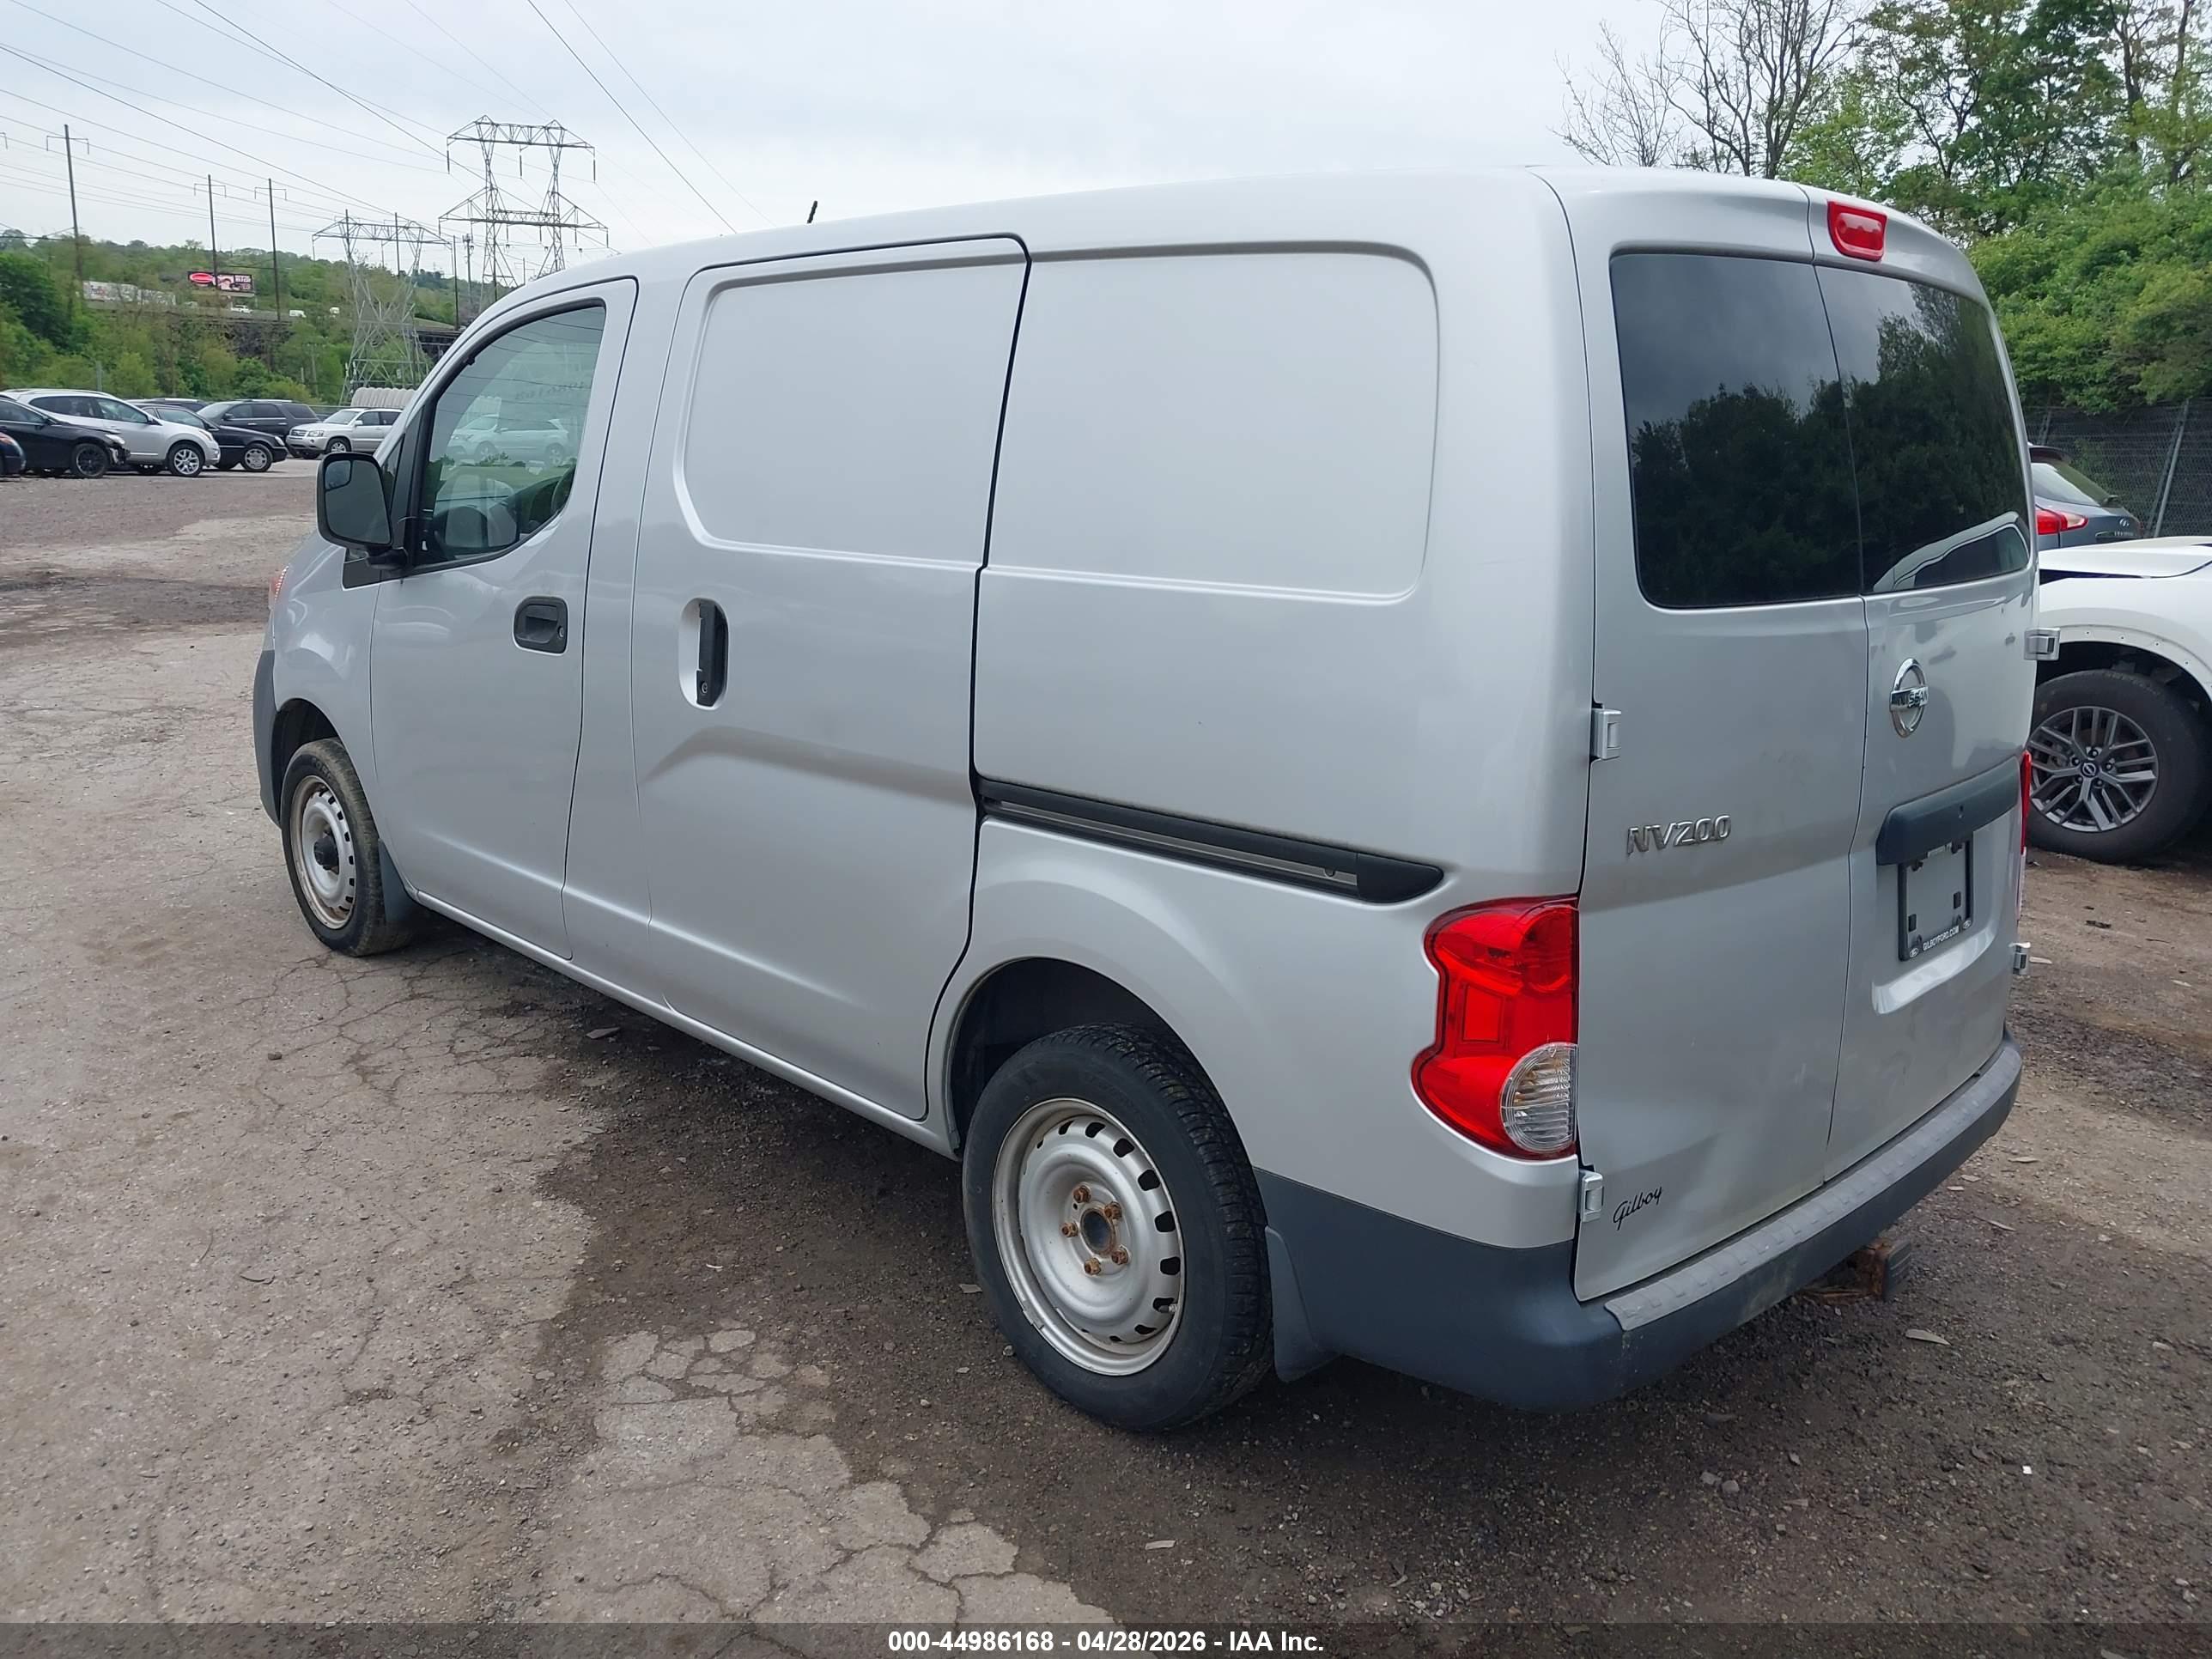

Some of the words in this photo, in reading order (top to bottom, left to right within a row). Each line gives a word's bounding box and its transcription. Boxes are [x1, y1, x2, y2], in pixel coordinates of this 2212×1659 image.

[1626, 814, 1732, 855] NV200
[1923, 926, 1960, 951] GILBOYFORD.COM
[1613, 1186, 1662, 1231] Gilboy
